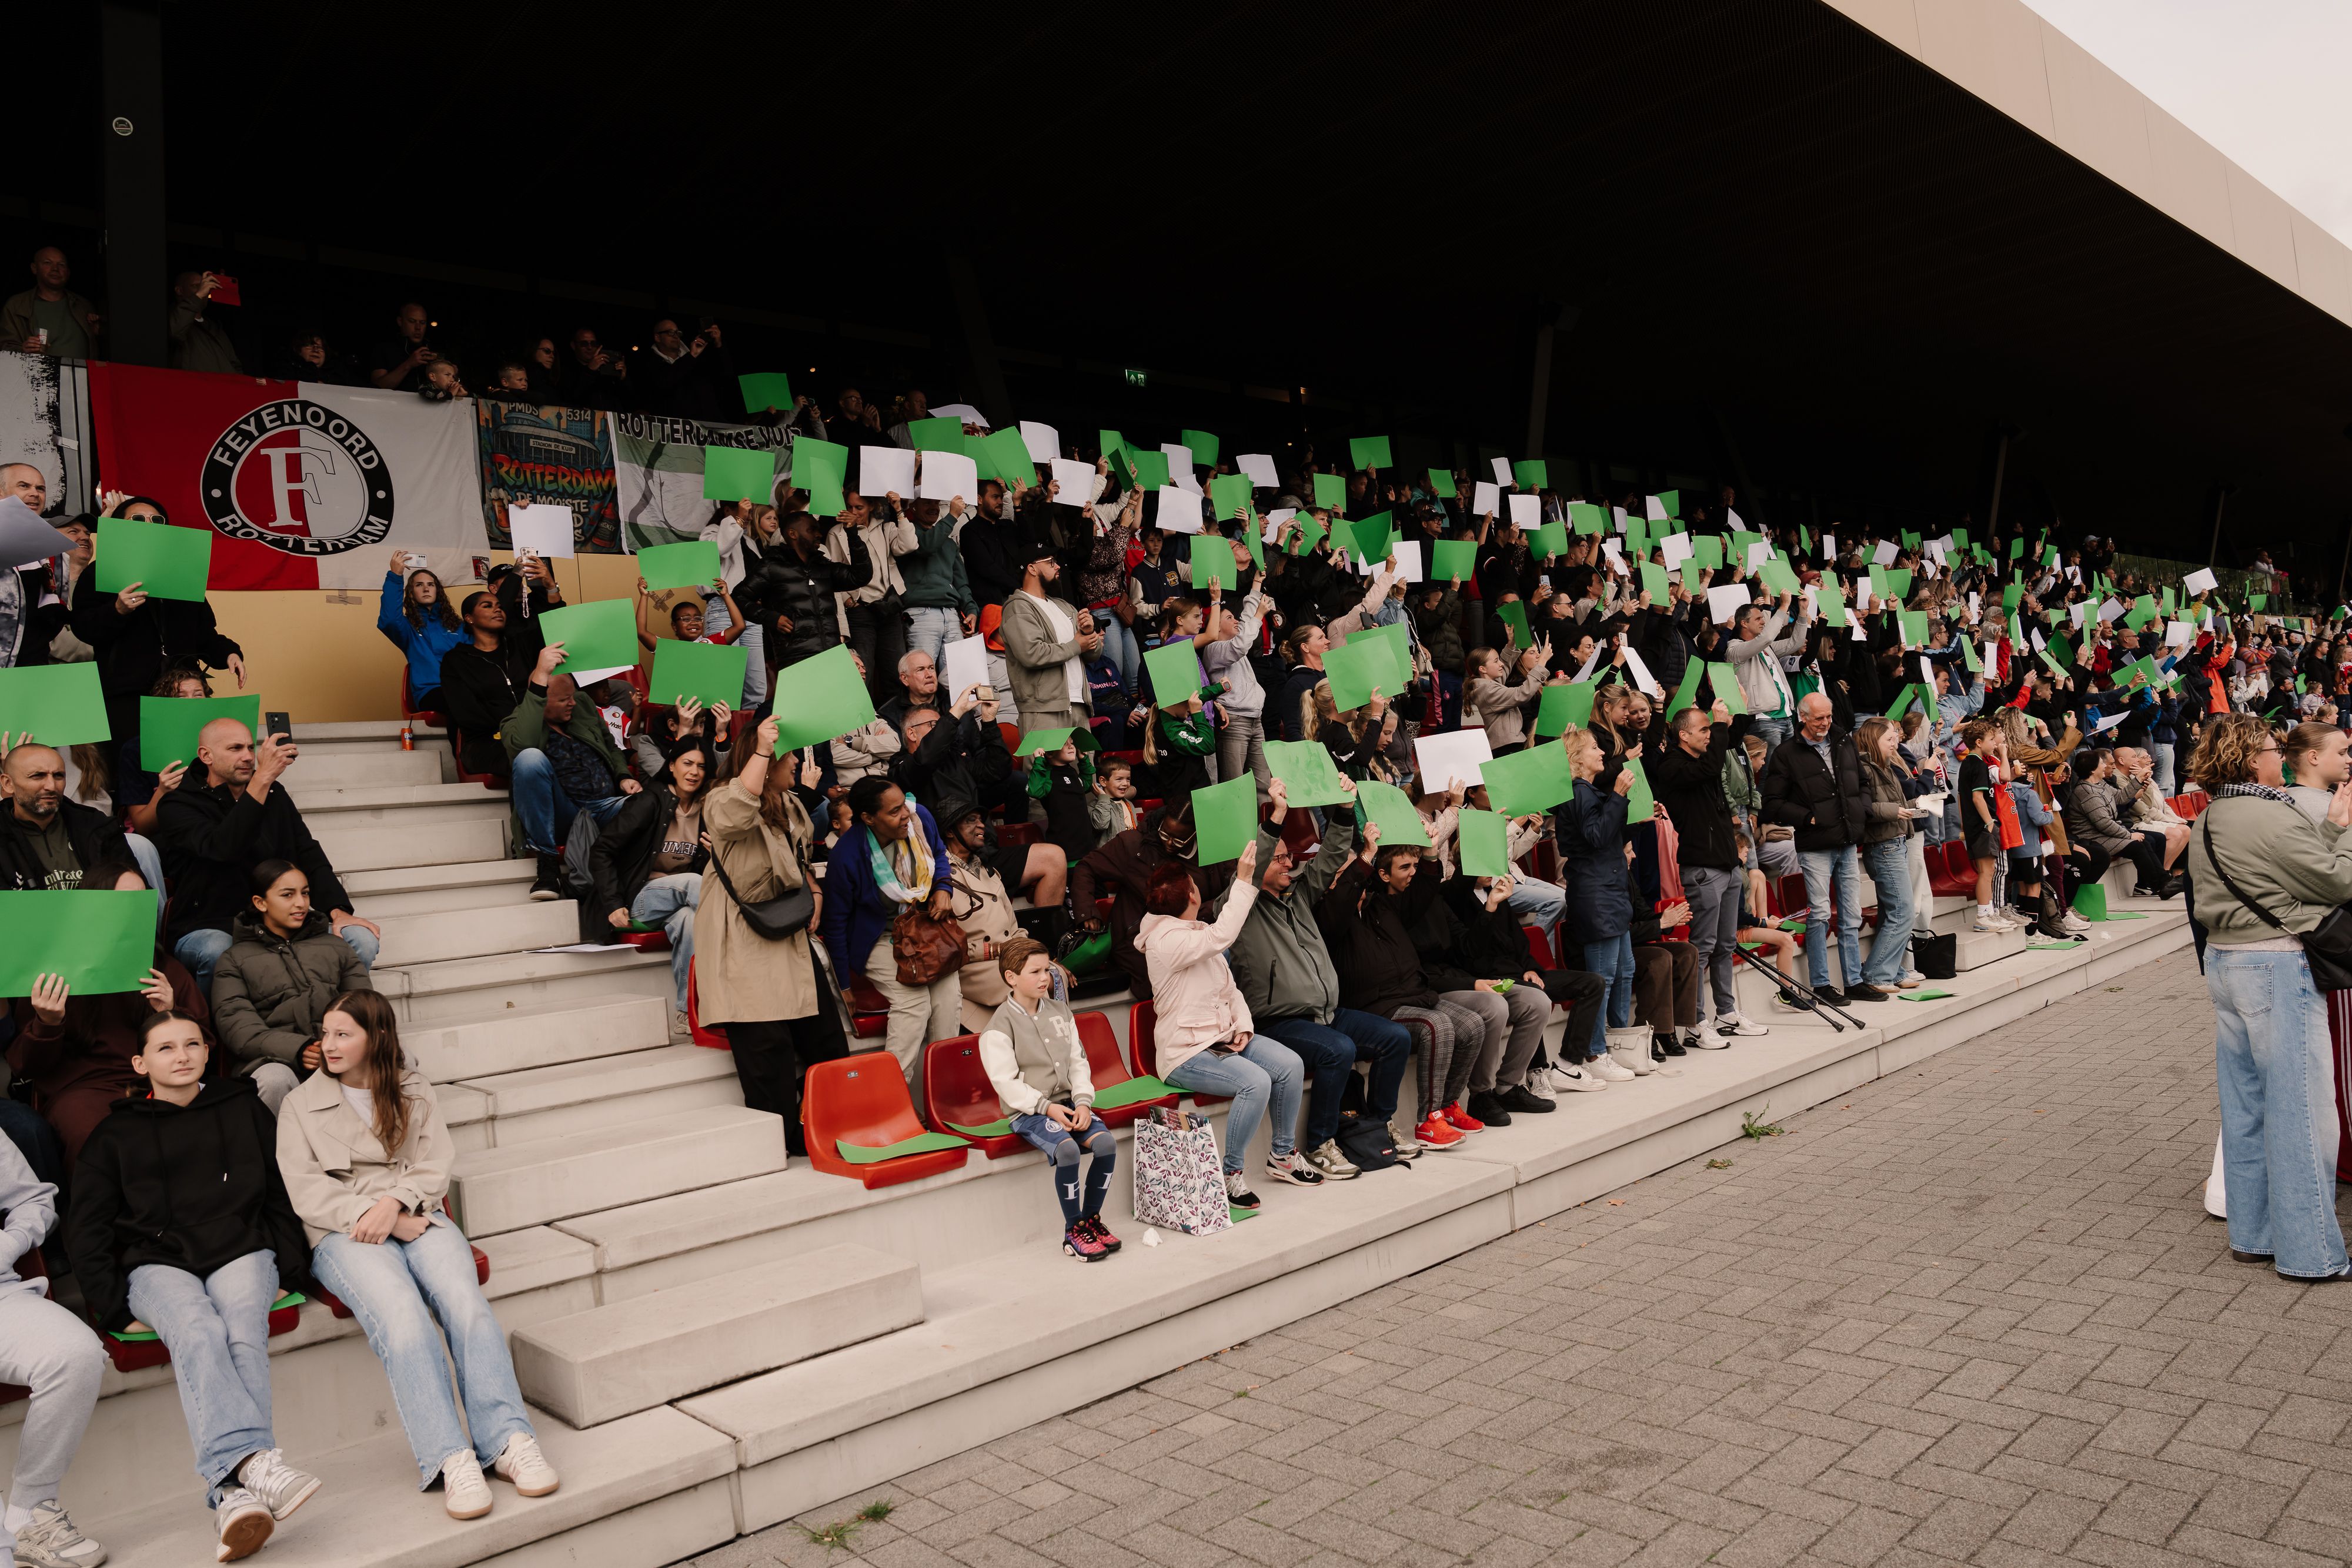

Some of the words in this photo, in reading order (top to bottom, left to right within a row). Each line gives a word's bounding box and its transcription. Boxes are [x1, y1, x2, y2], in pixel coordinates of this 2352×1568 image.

[509, 402, 539, 416] PMDS
[567, 409, 591, 421] 5314
[213, 403, 379, 469] FEYENOORD
[260, 446, 336, 527] F
[492, 453, 616, 497] ROTTERDAM
[216, 513, 389, 553] ROTTERDAM
[1088, 681, 1118, 690] TERMINALS
